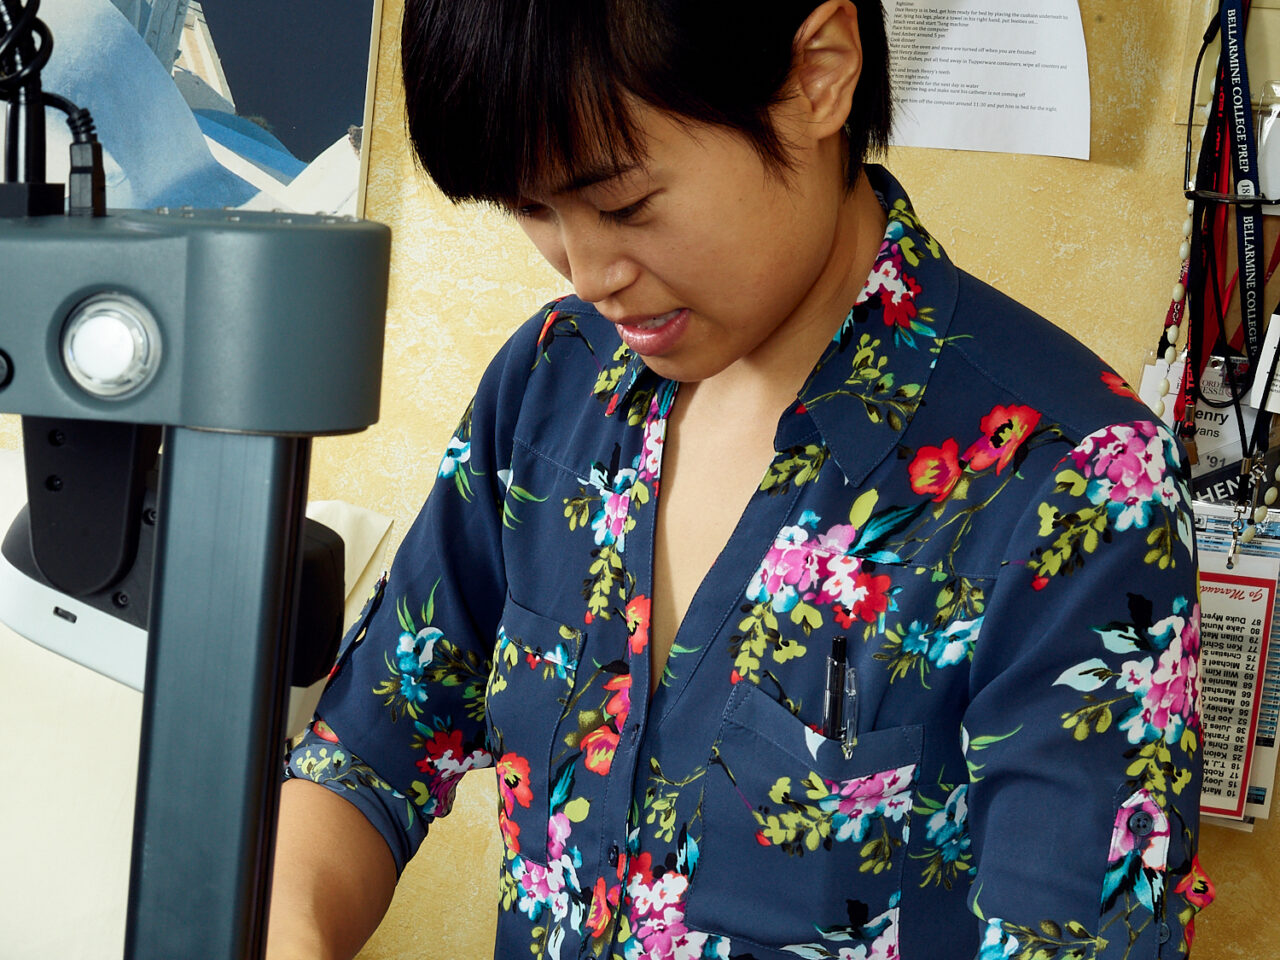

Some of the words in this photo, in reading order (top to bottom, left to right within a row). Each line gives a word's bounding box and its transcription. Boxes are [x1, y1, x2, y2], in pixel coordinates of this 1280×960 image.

[1227, 9, 1240, 85] BELLARMINE
[1233, 86, 1246, 142] COLLEGE
[1237, 144, 1250, 172] PREP
[1241, 184, 1250, 194] 18
[1243, 216, 1256, 289] BELLARMINE
[1246, 290, 1257, 343] COLLEGE
[1195, 409, 1229, 426] enry
[1195, 427, 1220, 438] vans
[1249, 589, 1263, 602] Go
[1226, 616, 1246, 624] Duke
[1221, 634, 1244, 642] Dillan
[1211, 651, 1241, 659] Christian
[1209, 678, 1237, 687] Mannie
[1208, 696, 1235, 705] Mason
[1207, 704, 1233, 714] Ashley
[1210, 724, 1231, 732] Jules
[1209, 741, 1228, 750] Chris
[1204, 777, 1223, 786] Joey
